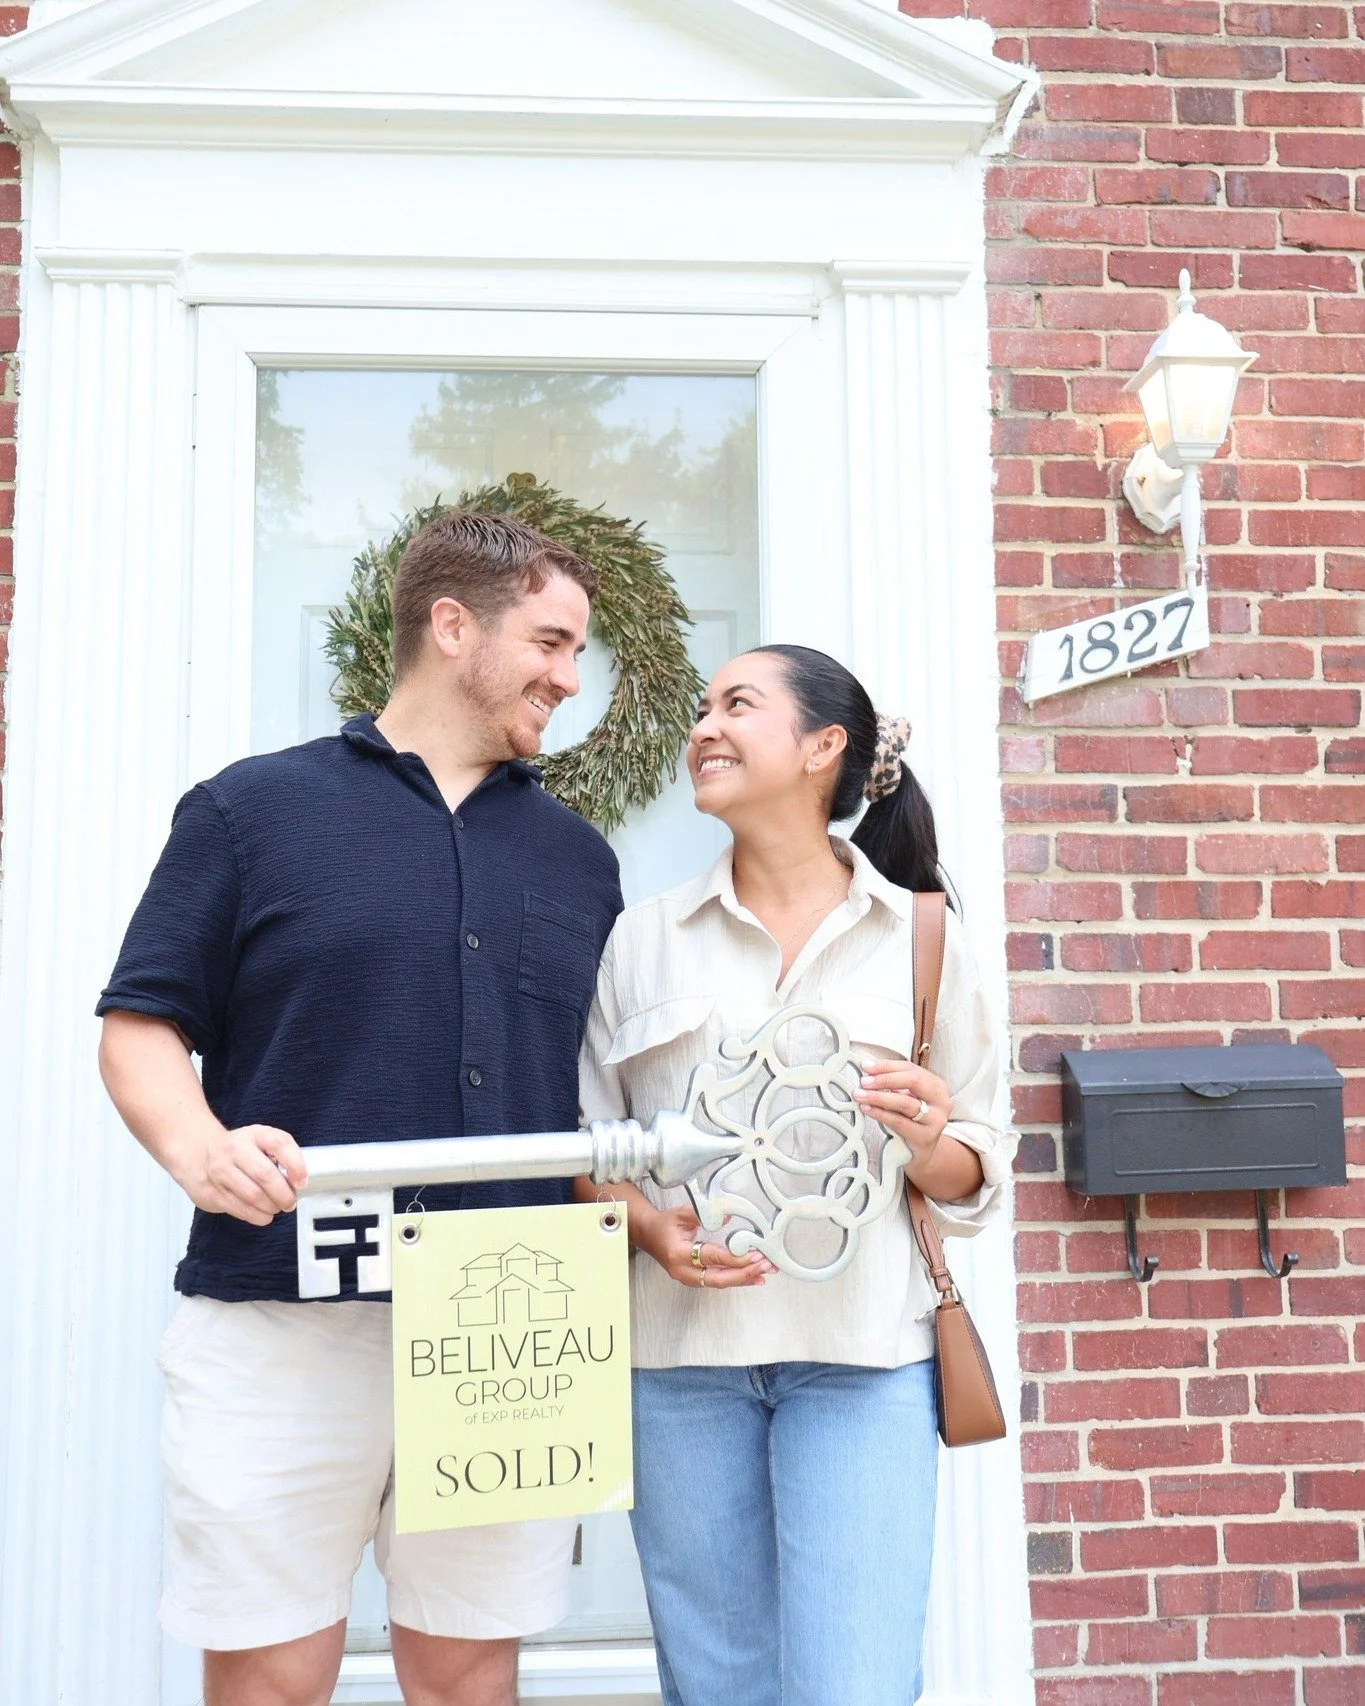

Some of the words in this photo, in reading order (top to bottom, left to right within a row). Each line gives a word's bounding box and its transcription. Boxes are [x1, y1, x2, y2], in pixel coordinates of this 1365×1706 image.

[1058, 597, 1195, 682] 1827
[410, 1325, 614, 1378] BELIVEAU
[455, 1374, 573, 1407] GROUP
[464, 1412, 478, 1425] of
[482, 1409, 508, 1424] EXP
[513, 1405, 565, 1421] REALTY
[435, 1442, 594, 1498] SOLD!
